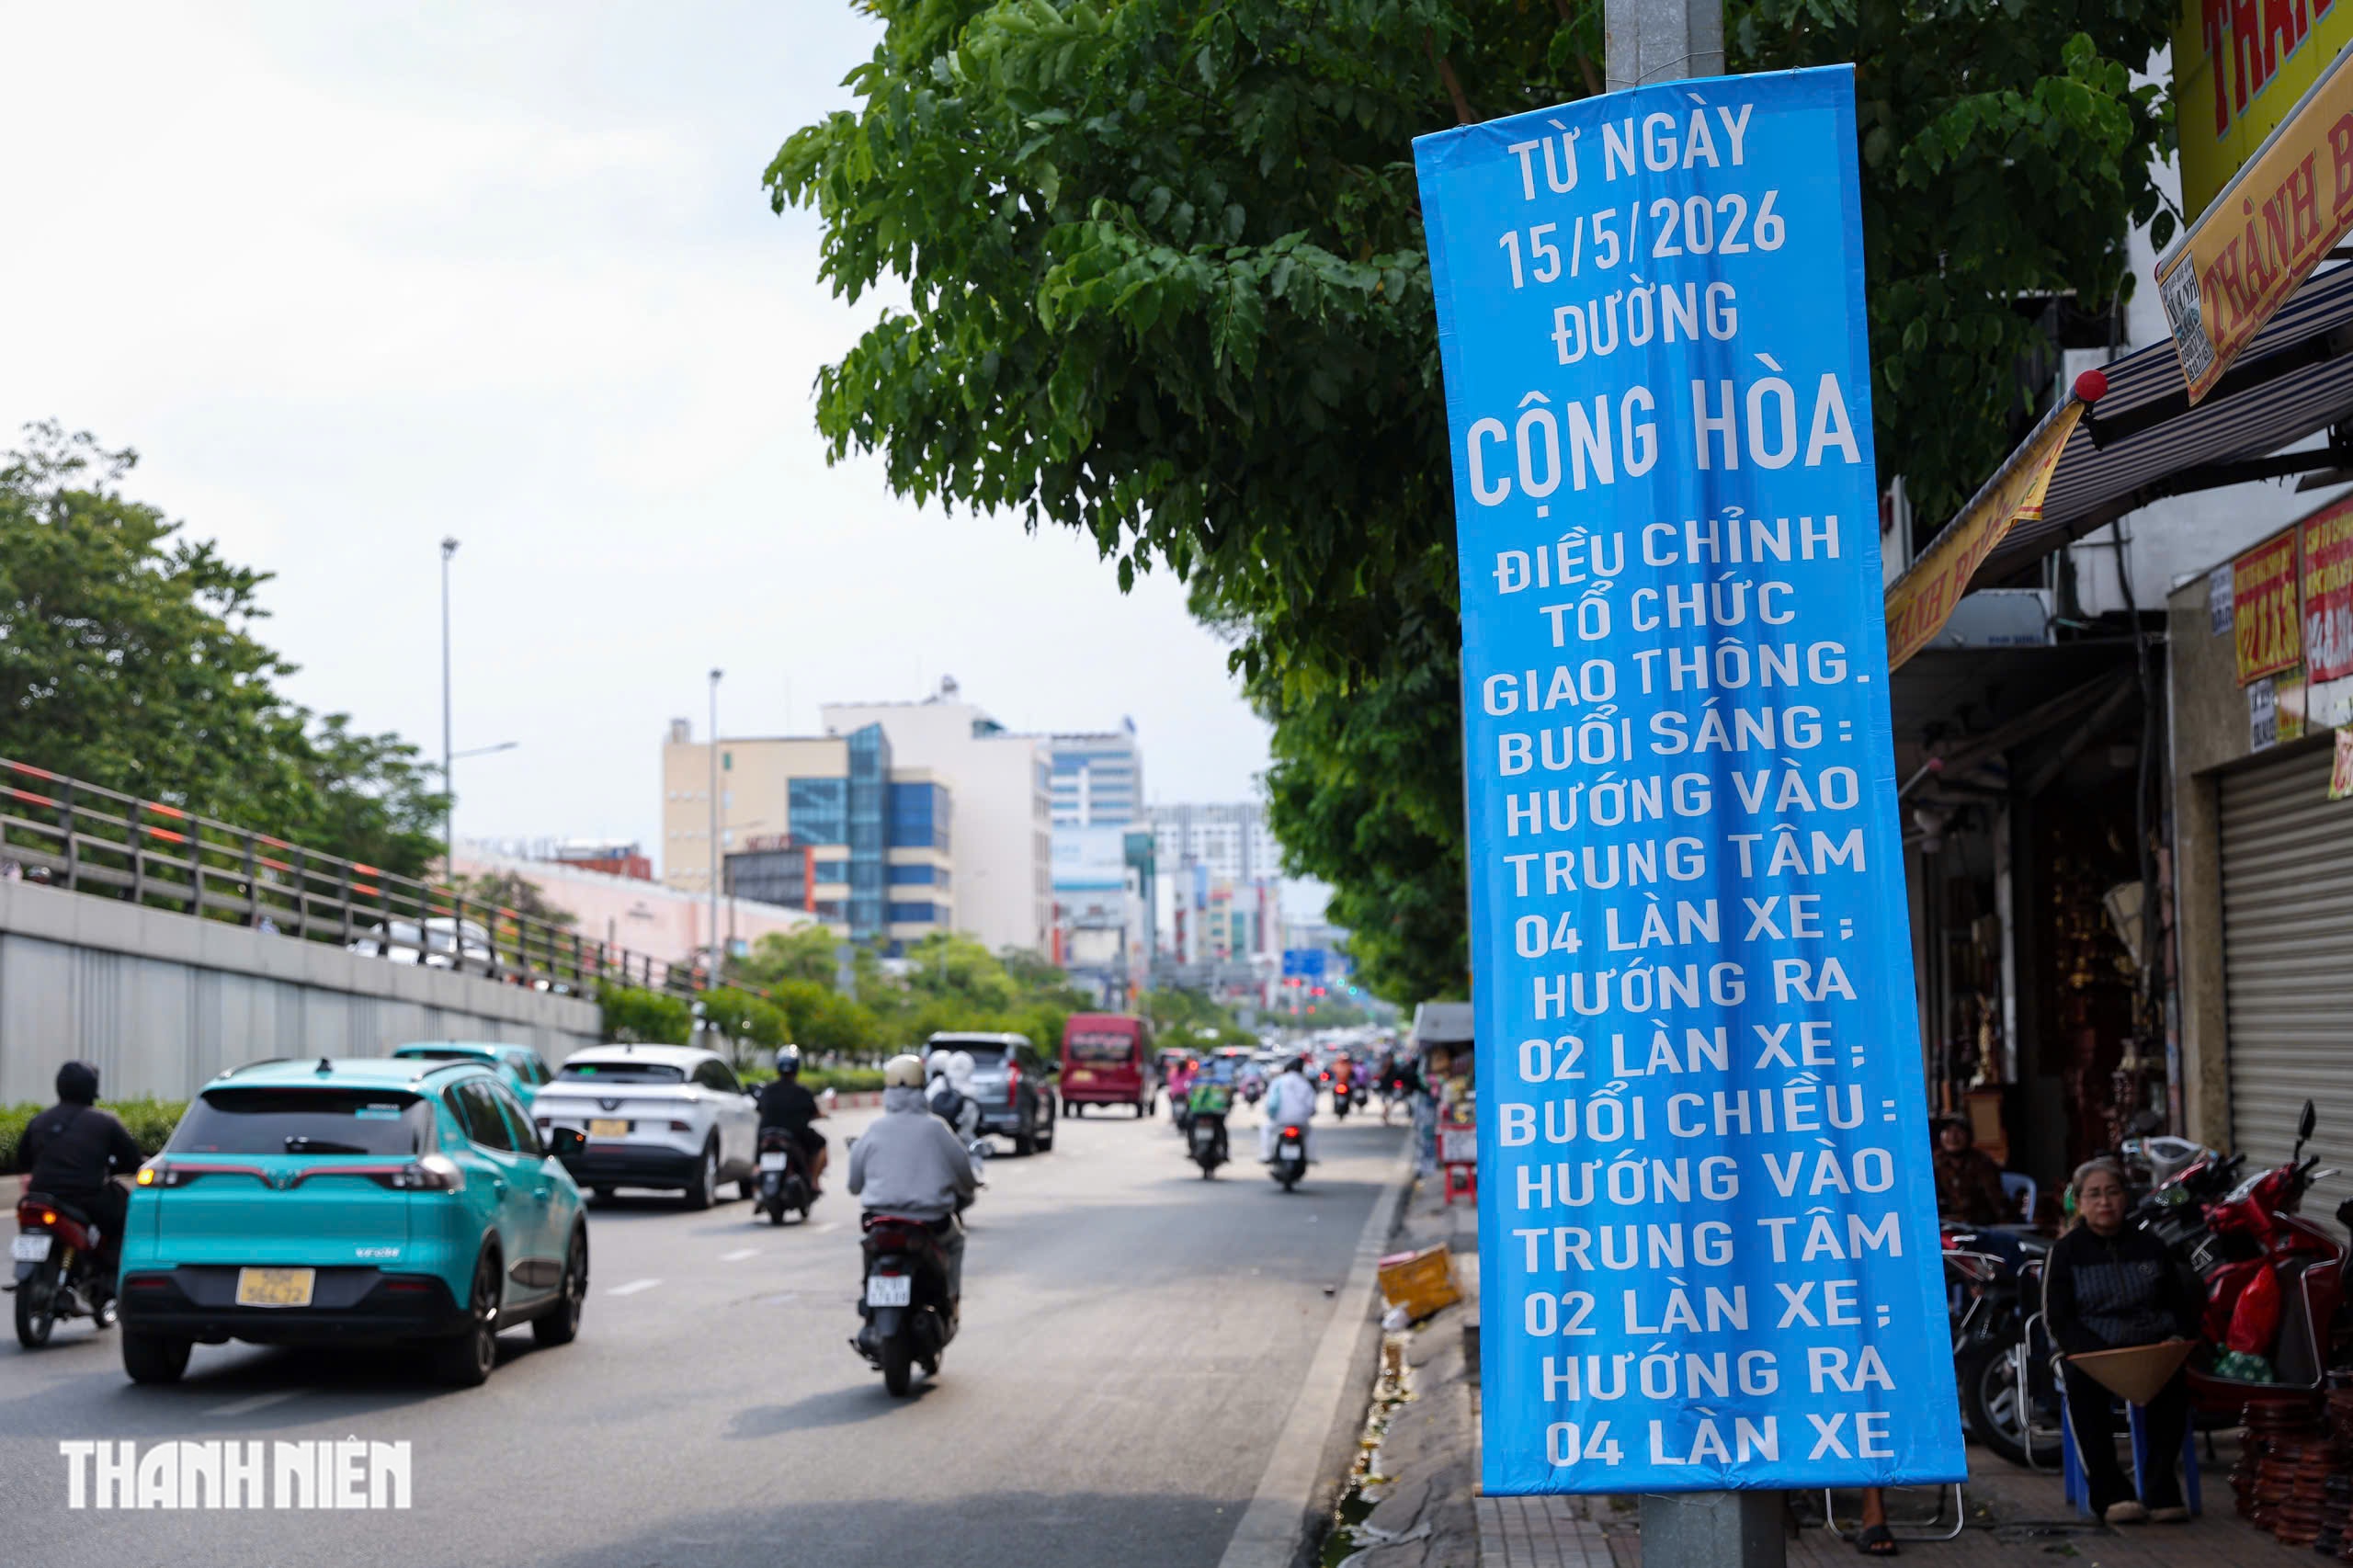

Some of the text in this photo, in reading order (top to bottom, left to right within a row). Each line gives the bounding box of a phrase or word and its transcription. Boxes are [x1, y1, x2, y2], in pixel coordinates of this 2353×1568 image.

[1509, 96, 1752, 199] TỪ NGÀY
[1500, 191, 1785, 288] 15/5/2026
[1552, 273, 1736, 364] ĐƯỜNG
[1468, 354, 1860, 517] CỘNG HÒA
[1494, 506, 1839, 593] ĐIỀU CHỈNH
[1540, 573, 1794, 646] TỔ CHỨC
[1484, 660, 1615, 715] GIAO
[1500, 705, 1631, 775] BUỔI
[1507, 758, 1859, 835] HƯỚNG VÀO
[1505, 824, 1865, 896] TRUNG TÂM
[1517, 912, 1582, 958] 04
[1607, 892, 1719, 950] LÀN
[1535, 958, 1856, 1018] HƯỚNG RA
[1519, 1036, 1585, 1082] 02
[1612, 1019, 1733, 1077] LÀN
[1500, 1081, 1644, 1146] BUỔI
[1518, 1139, 1893, 1209] HƯỚNG VÀO
[1513, 1208, 1902, 1272] TRUNG TÂM
[1526, 1291, 1596, 1335] 02
[1625, 1278, 1747, 1334] LÀN
[1544, 1343, 1894, 1401] HƯỚNG RA
[1547, 1406, 1893, 1466] 04 LÀN XE
